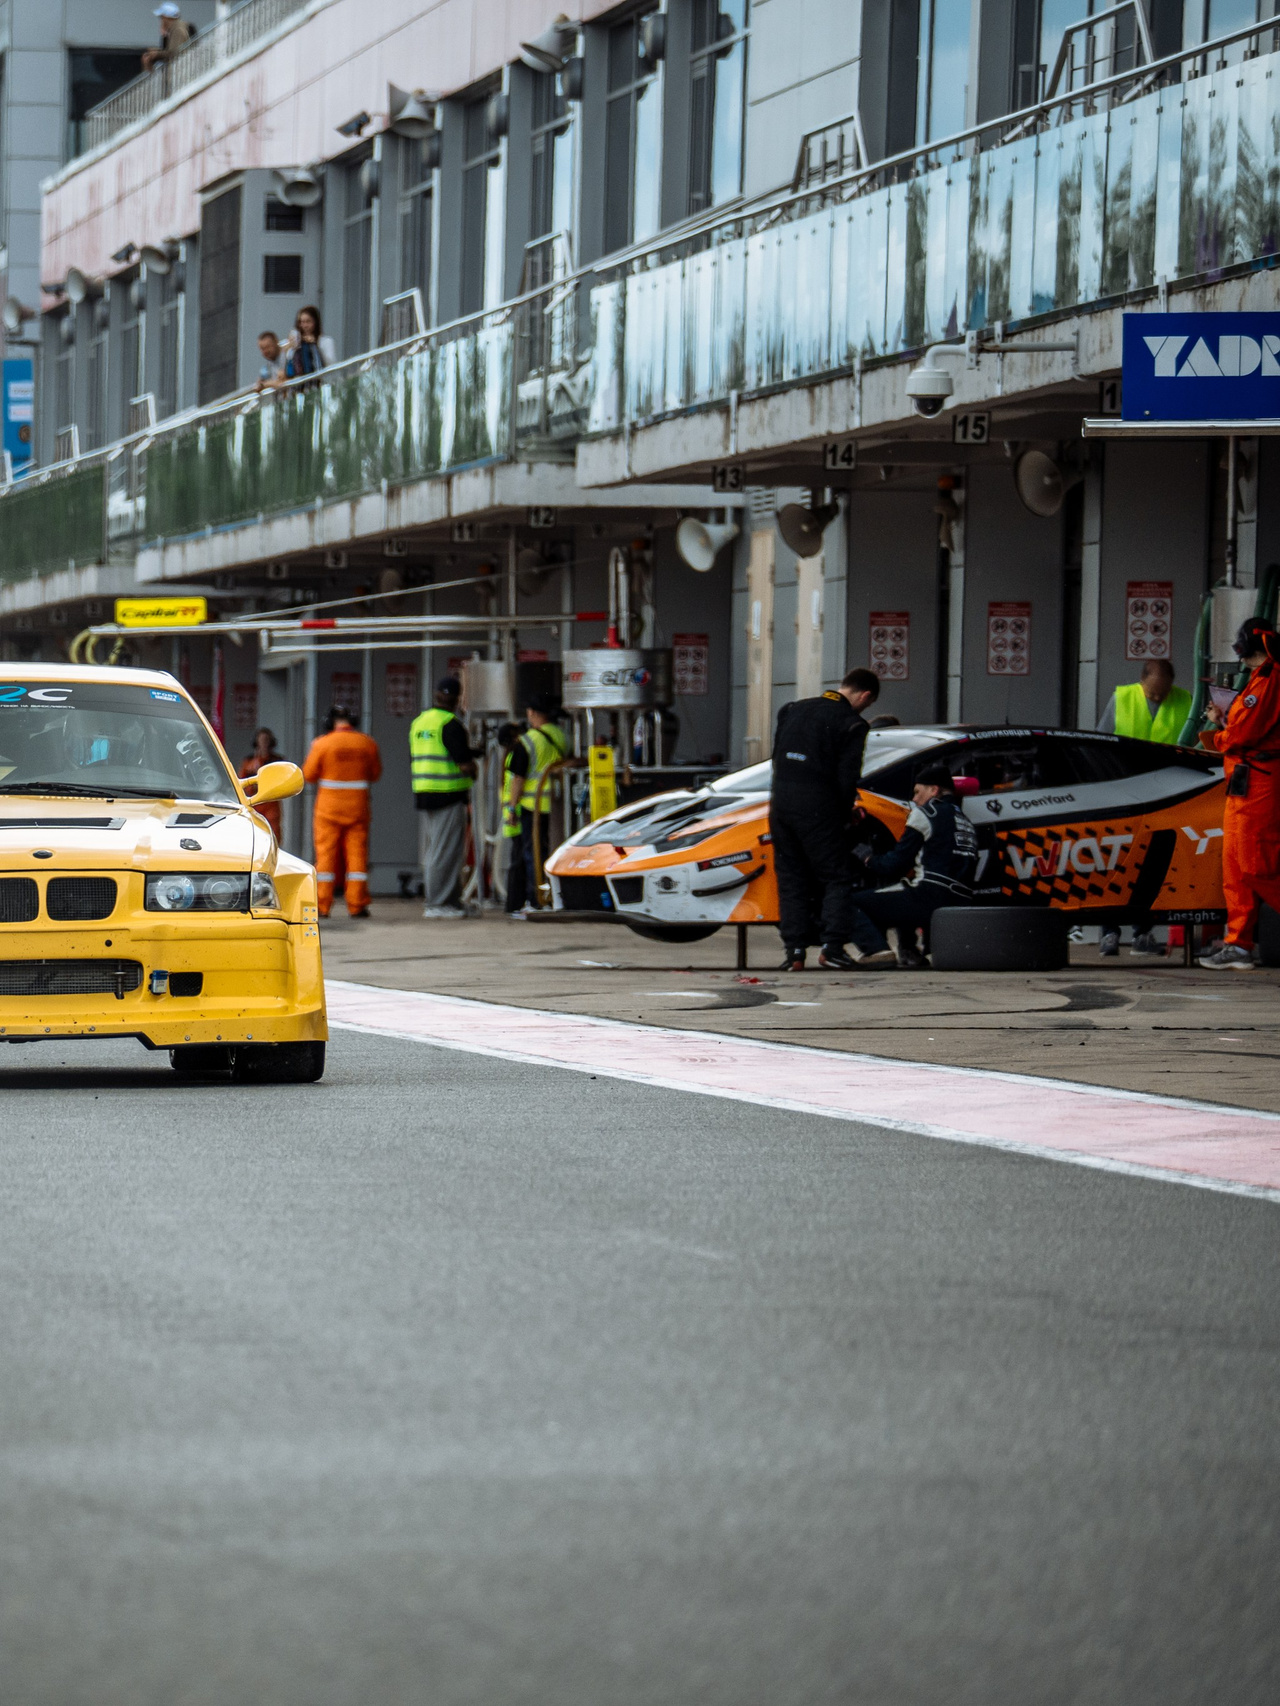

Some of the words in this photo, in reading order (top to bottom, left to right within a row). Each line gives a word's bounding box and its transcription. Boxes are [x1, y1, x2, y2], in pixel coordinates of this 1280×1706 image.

[958, 415, 986, 440] 15
[826, 443, 853, 467] 14
[719, 467, 740, 488] 13
[532, 506, 554, 525] 12
[1010, 793, 1075, 810] OpenYard
